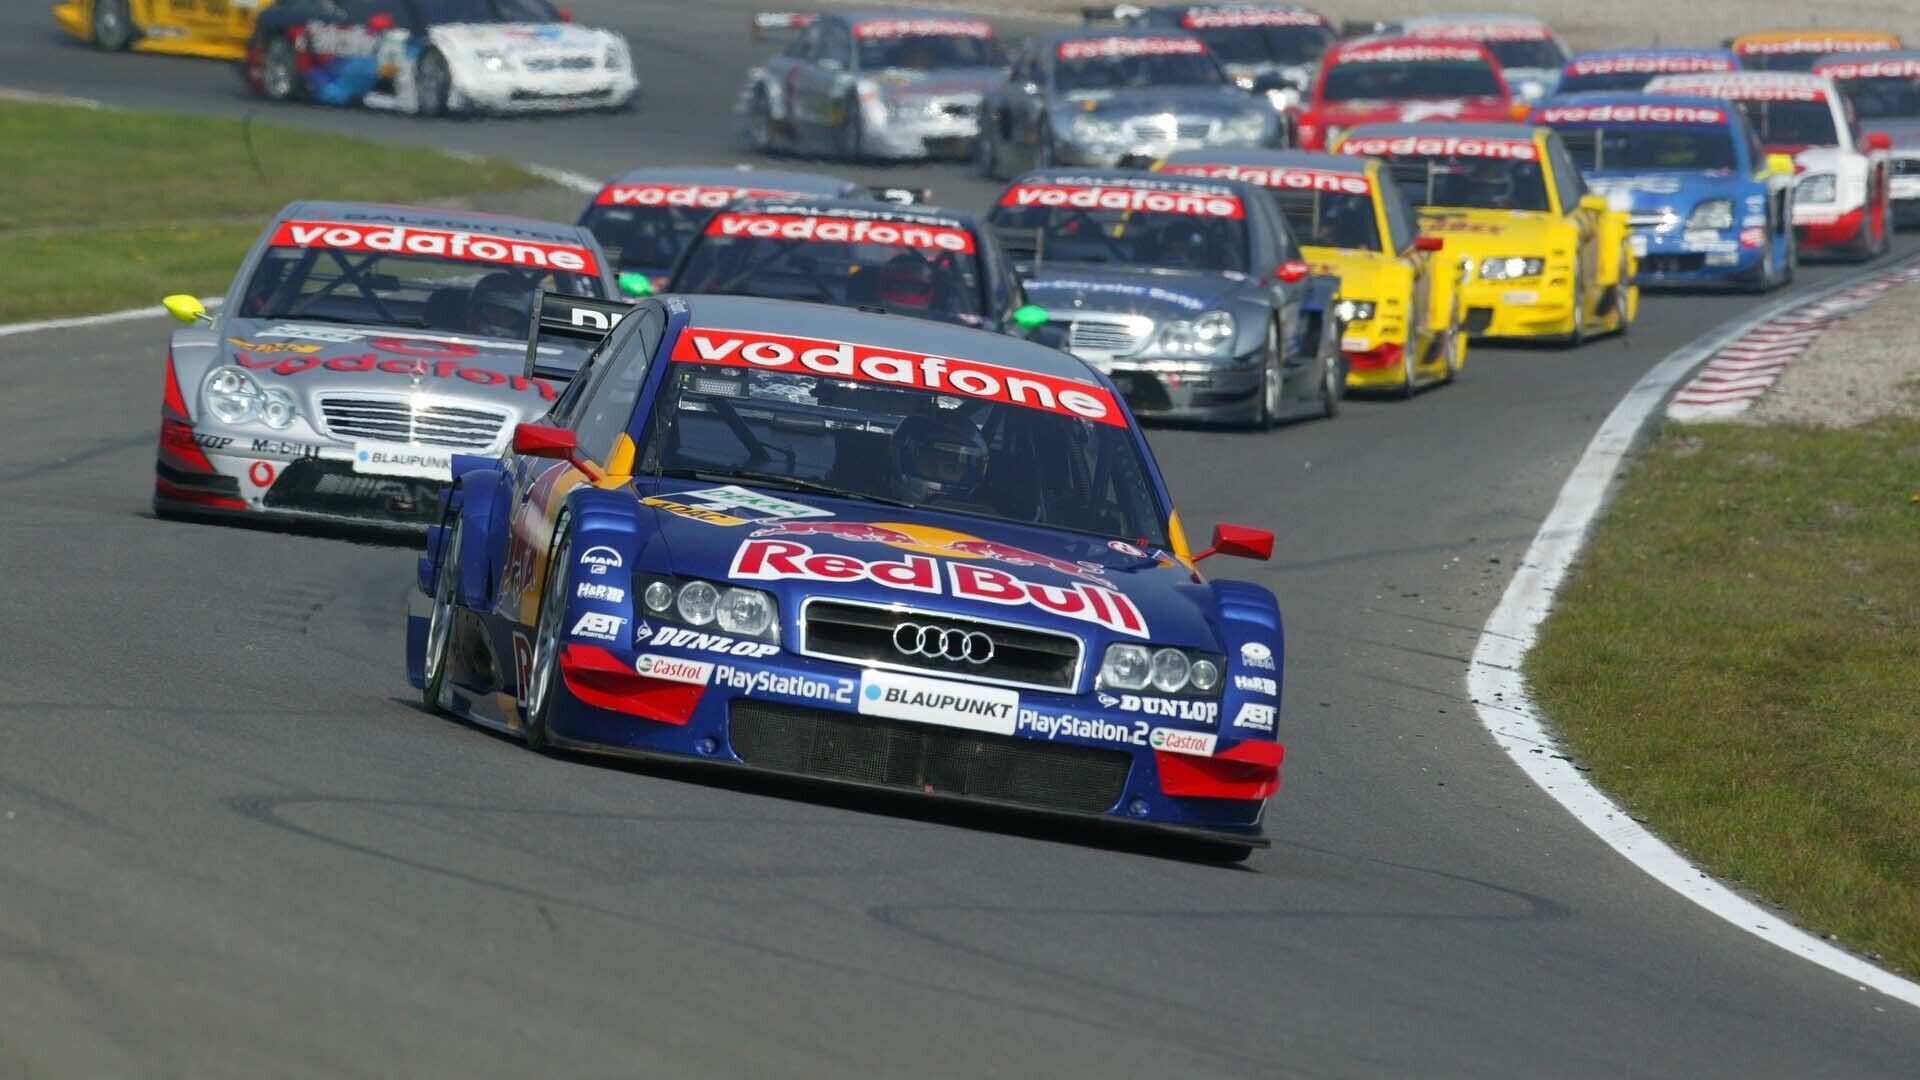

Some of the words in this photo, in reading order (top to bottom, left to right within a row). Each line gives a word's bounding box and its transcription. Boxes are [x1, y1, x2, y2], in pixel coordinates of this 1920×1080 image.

[1545, 105, 1719, 123] vodafone
[1342, 137, 1536, 160] vodafone
[613, 185, 747, 208] voda
[1017, 186, 1235, 217] vodafone
[721, 214, 966, 251] vodafone
[289, 224, 586, 270] vodafone
[234, 352, 560, 402] vodafon
[693, 335, 1110, 420] vodafone
[371, 451, 451, 470] BLAUPUNK
[584, 555, 620, 567] MAN
[728, 538, 942, 594] Red
[946, 560, 1150, 640] Bull
[571, 611, 628, 636] ABT
[649, 626, 781, 658] DUNLOP
[652, 658, 703, 681] Castrol
[884, 687, 1013, 720] BLAUPUNKT
[1118, 694, 1219, 725] DUNLOP
[1233, 702, 1277, 727] ABT
[1165, 731, 1207, 753] Castrol
